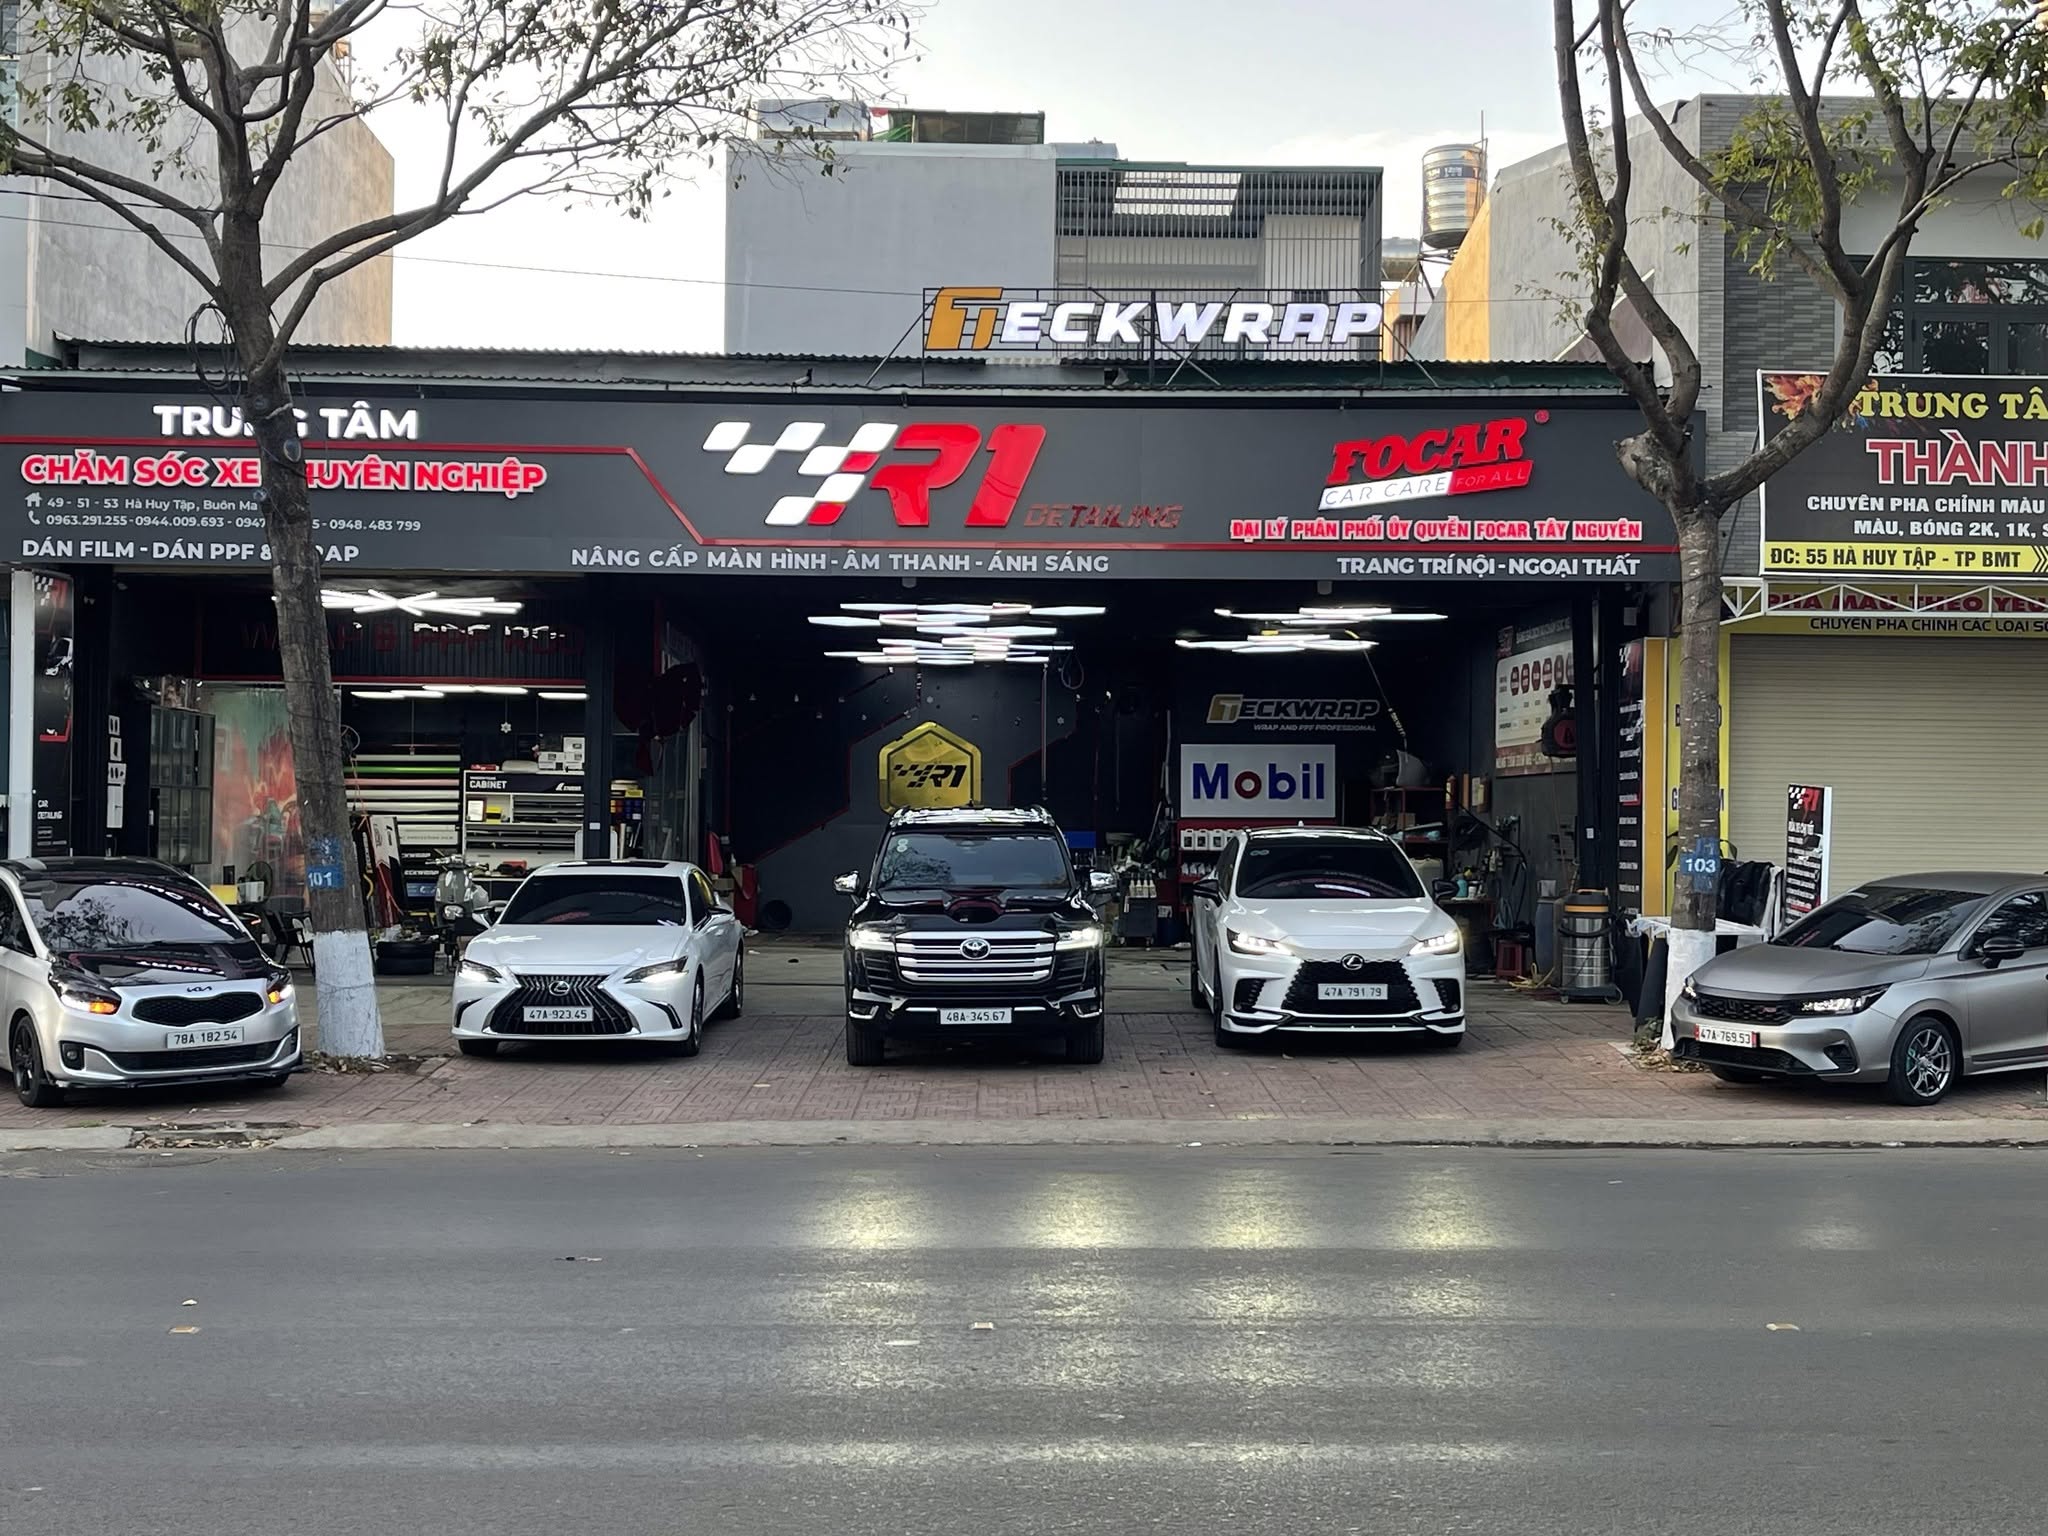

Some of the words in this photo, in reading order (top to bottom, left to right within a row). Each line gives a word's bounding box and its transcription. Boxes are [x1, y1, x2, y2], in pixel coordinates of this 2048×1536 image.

[925, 287, 1383, 350] TECKWRAP
[1856, 390, 1989, 419] TRUNG
[153, 405, 308, 438] TRU
[319, 400, 418, 439] TÂM
[1326, 417, 1527, 485] FOCAR
[1866, 429, 2048, 486] THÀNH
[21, 449, 132, 485] CHĂM
[132, 450, 208, 487] SÓC
[211, 457, 262, 487] XE
[305, 454, 411, 490] HUYÊN
[413, 457, 548, 498] NGHIỆP
[870, 423, 1046, 527] R1
[1325, 487, 1373, 506] CAR
[1384, 476, 1448, 497] CARE
[1456, 475, 1487, 487] FOR
[1491, 468, 1527, 483] ALL
[47, 498, 64, 508] 49
[77, 498, 90, 508] 51
[103, 499, 119, 509] 53
[125, 498, 142, 509] Hà
[145, 499, 170, 512] Huy
[203, 499, 236, 511] Buôn
[239, 500, 258, 511] Ma
[1023, 503, 1183, 528] DETAILING
[1807, 495, 1884, 512] CHUYÊN
[1890, 498, 1930, 512] PHA
[1934, 495, 1995, 513] CHỈNH
[2001, 497, 2046, 514] MÀU
[1230, 519, 1262, 543] ĐẠI
[1264, 517, 1288, 540] LÝ
[1291, 517, 1339, 540] PHÂN
[1342, 515, 1384, 540] PHỐI
[1474, 520, 1532, 540] FOCAR
[1535, 517, 1569, 540] TÂY
[1572, 517, 1643, 541] NGUYÊN
[1854, 519, 1903, 537] MÀU,
[1910, 519, 1963, 537] BÓNG
[1969, 522, 2000, 539] 2K,
[2006, 523, 2036, 539] 1K,
[22, 536, 73, 557] DÁN
[80, 540, 134, 558] FILM
[152, 538, 203, 559] DÁN
[210, 542, 255, 560] PPF
[571, 545, 640, 567] NÂNG
[649, 544, 698, 567] CẤP
[707, 547, 761, 569] MÀN
[771, 548, 826, 570] HÌNH
[843, 549, 880, 570] ÂM
[889, 553, 970, 570] THANH
[988, 550, 1037, 572] ÁNH
[1045, 551, 1109, 572] SÁNG
[1770, 548, 1800, 565] ĐC:
[1806, 548, 1827, 565] 55
[1833, 546, 1857, 565] HÀ
[1863, 549, 1897, 566] HUY
[1903, 547, 1936, 570] TẬP
[1955, 550, 1976, 567] TP
[1982, 551, 2021, 568] BMT
[1337, 557, 1414, 575] TRANG
[1418, 553, 1456, 575] TRÍ
[1457, 554, 1495, 578] NỘI
[1509, 558, 1578, 578] NGOẠI
[1582, 553, 1641, 575] THẤT
[1876, 618, 1908, 631] PHA
[1207, 694, 1380, 723] TECKWRAP
[469, 780, 507, 789] CABINET
[1192, 763, 1325, 800] Mobil
[308, 871, 332, 887] 101
[1685, 858, 1716, 873] 103
